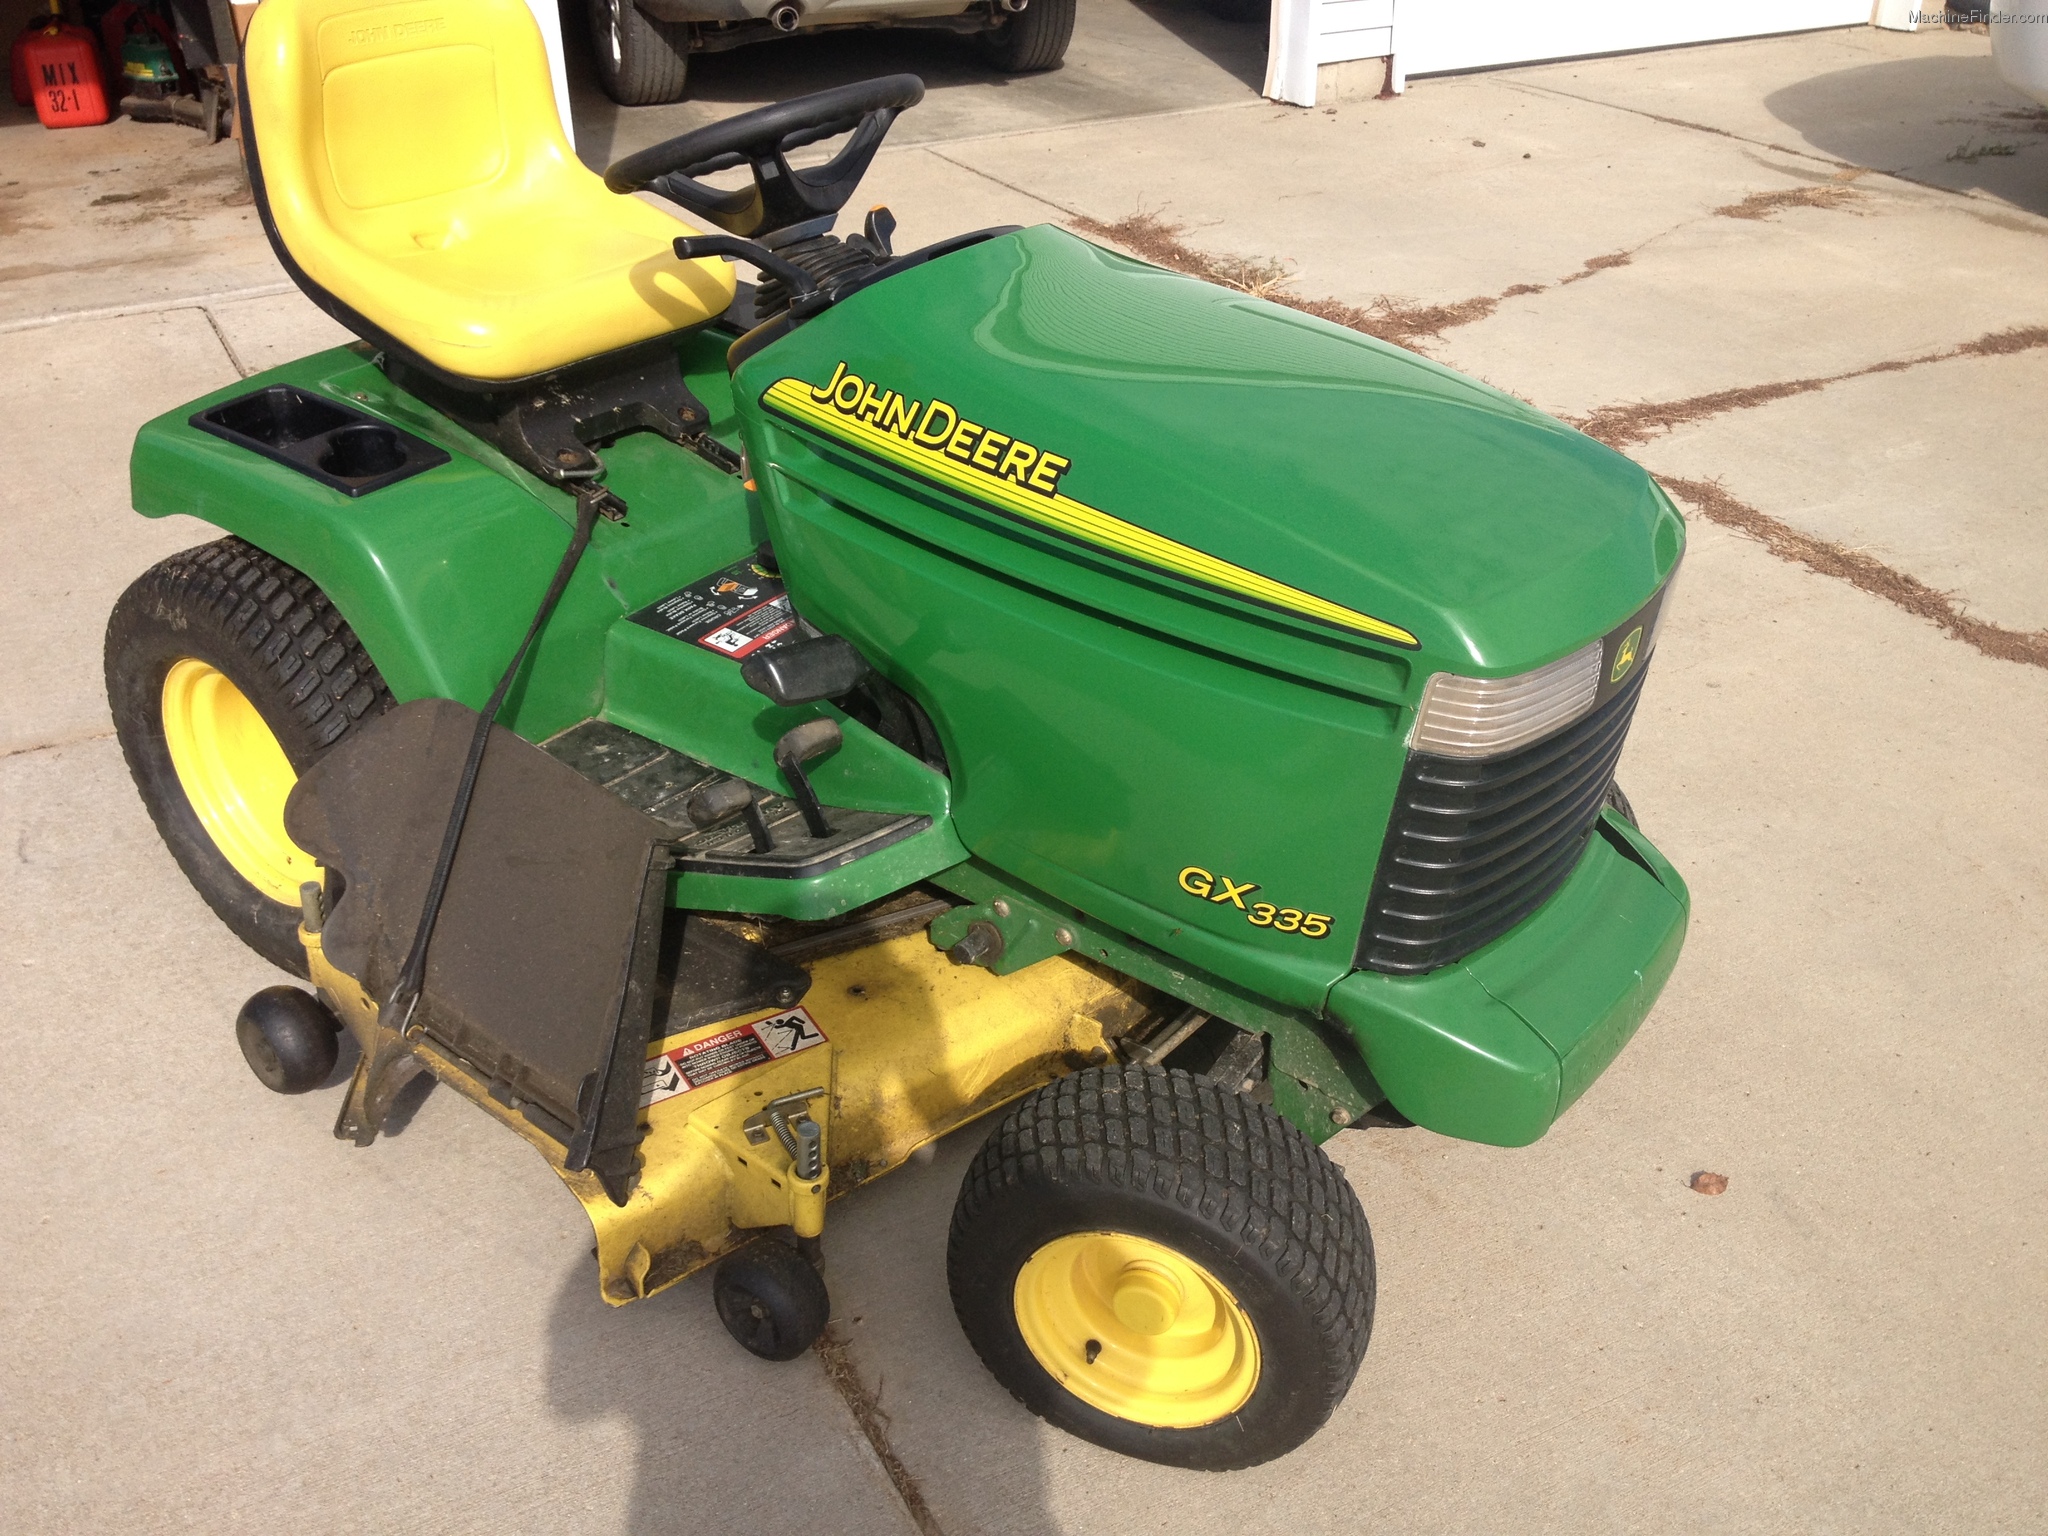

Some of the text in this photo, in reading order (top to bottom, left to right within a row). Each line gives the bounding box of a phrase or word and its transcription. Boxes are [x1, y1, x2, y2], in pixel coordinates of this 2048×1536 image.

[348, 17, 446, 46] JOHN DEERE
[41, 61, 80, 87] MIX
[811, 360, 1072, 499] JOHN DEERE
[693, 1030, 742, 1051] DANGER
